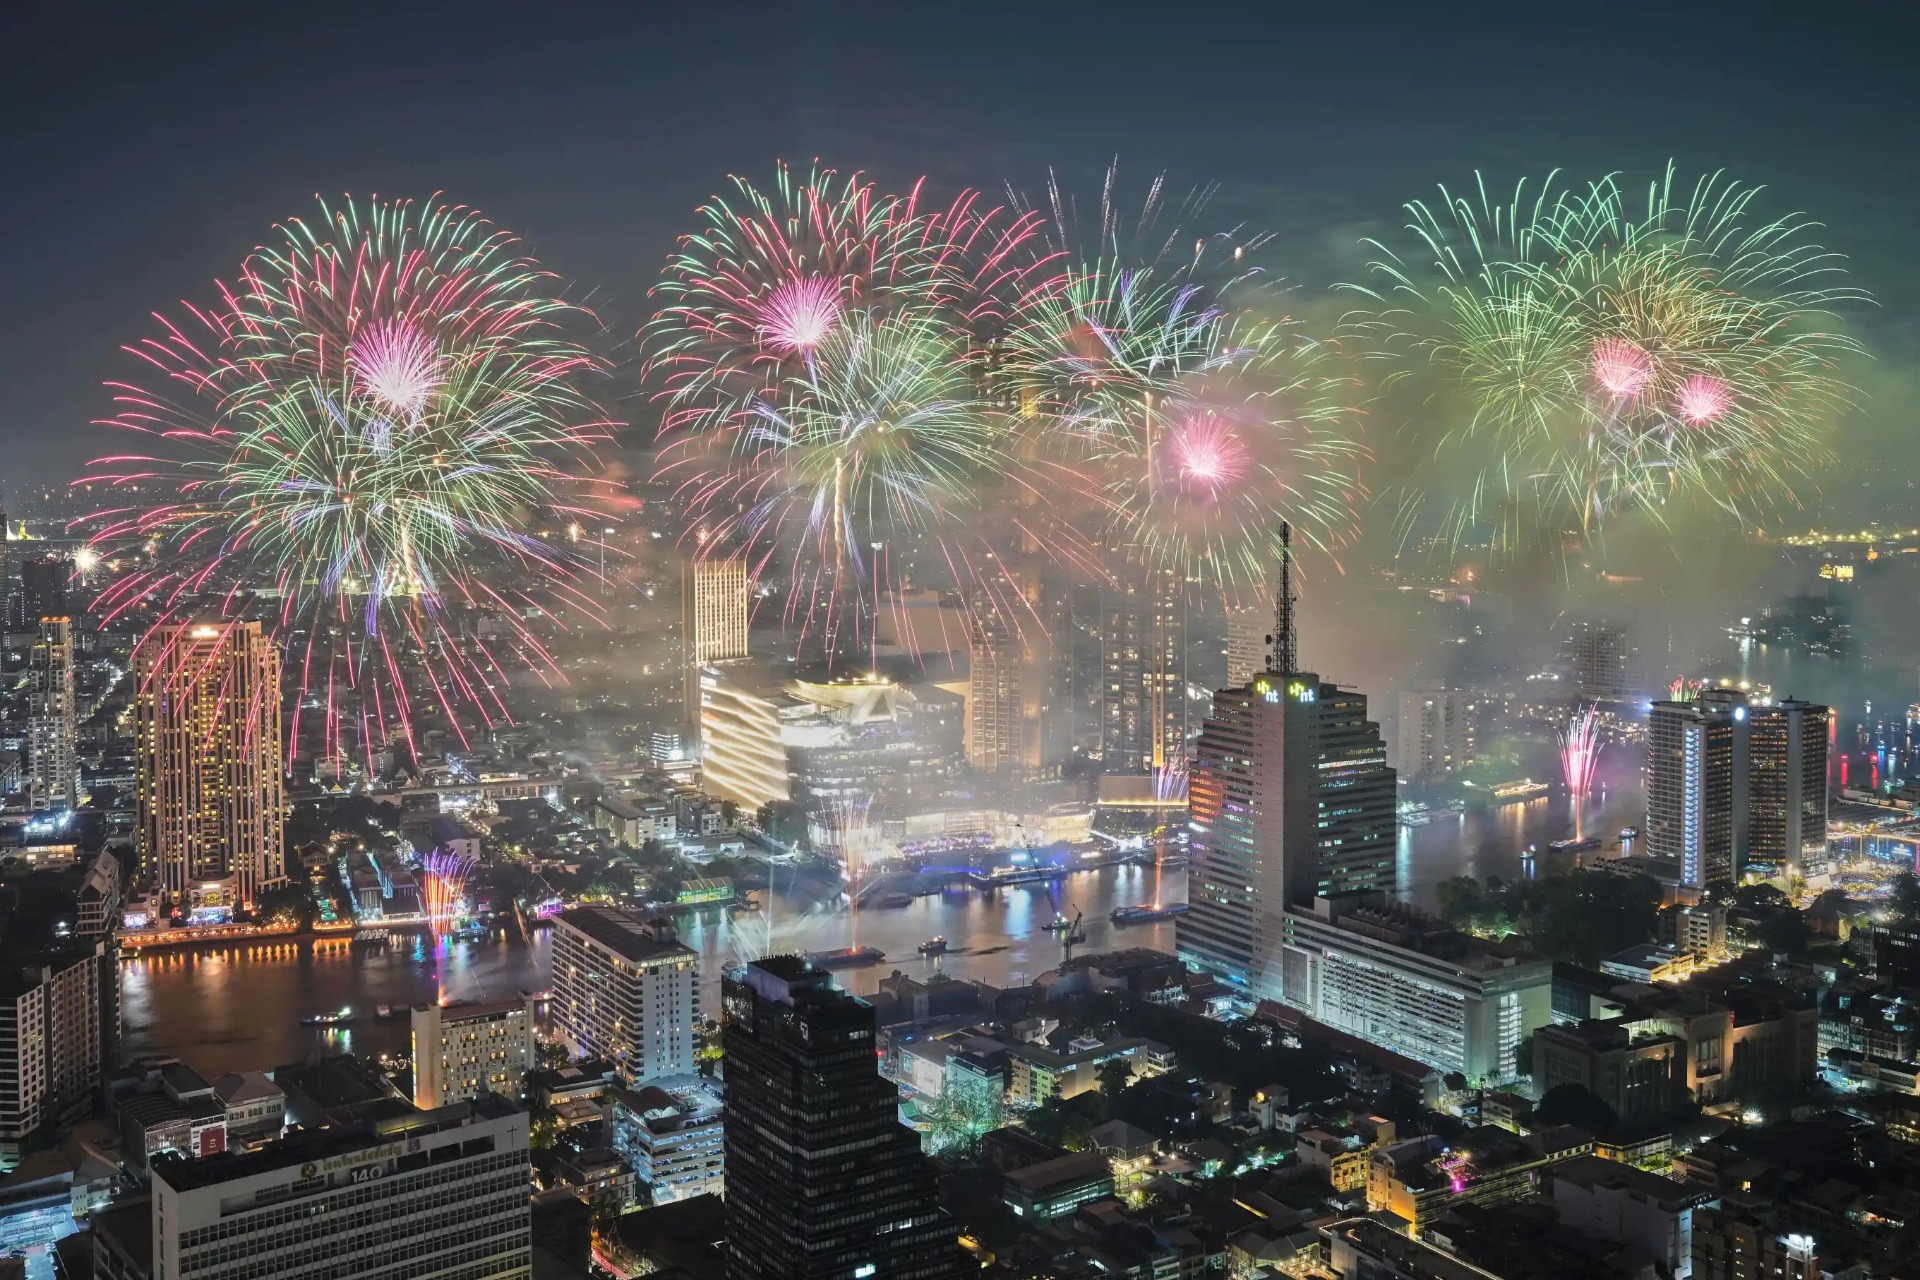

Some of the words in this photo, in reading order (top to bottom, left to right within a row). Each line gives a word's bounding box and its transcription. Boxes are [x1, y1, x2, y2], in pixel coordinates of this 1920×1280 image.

[1265, 689, 1279, 703] nt
[1300, 688, 1315, 702] nt
[351, 1165, 383, 1184] 140
